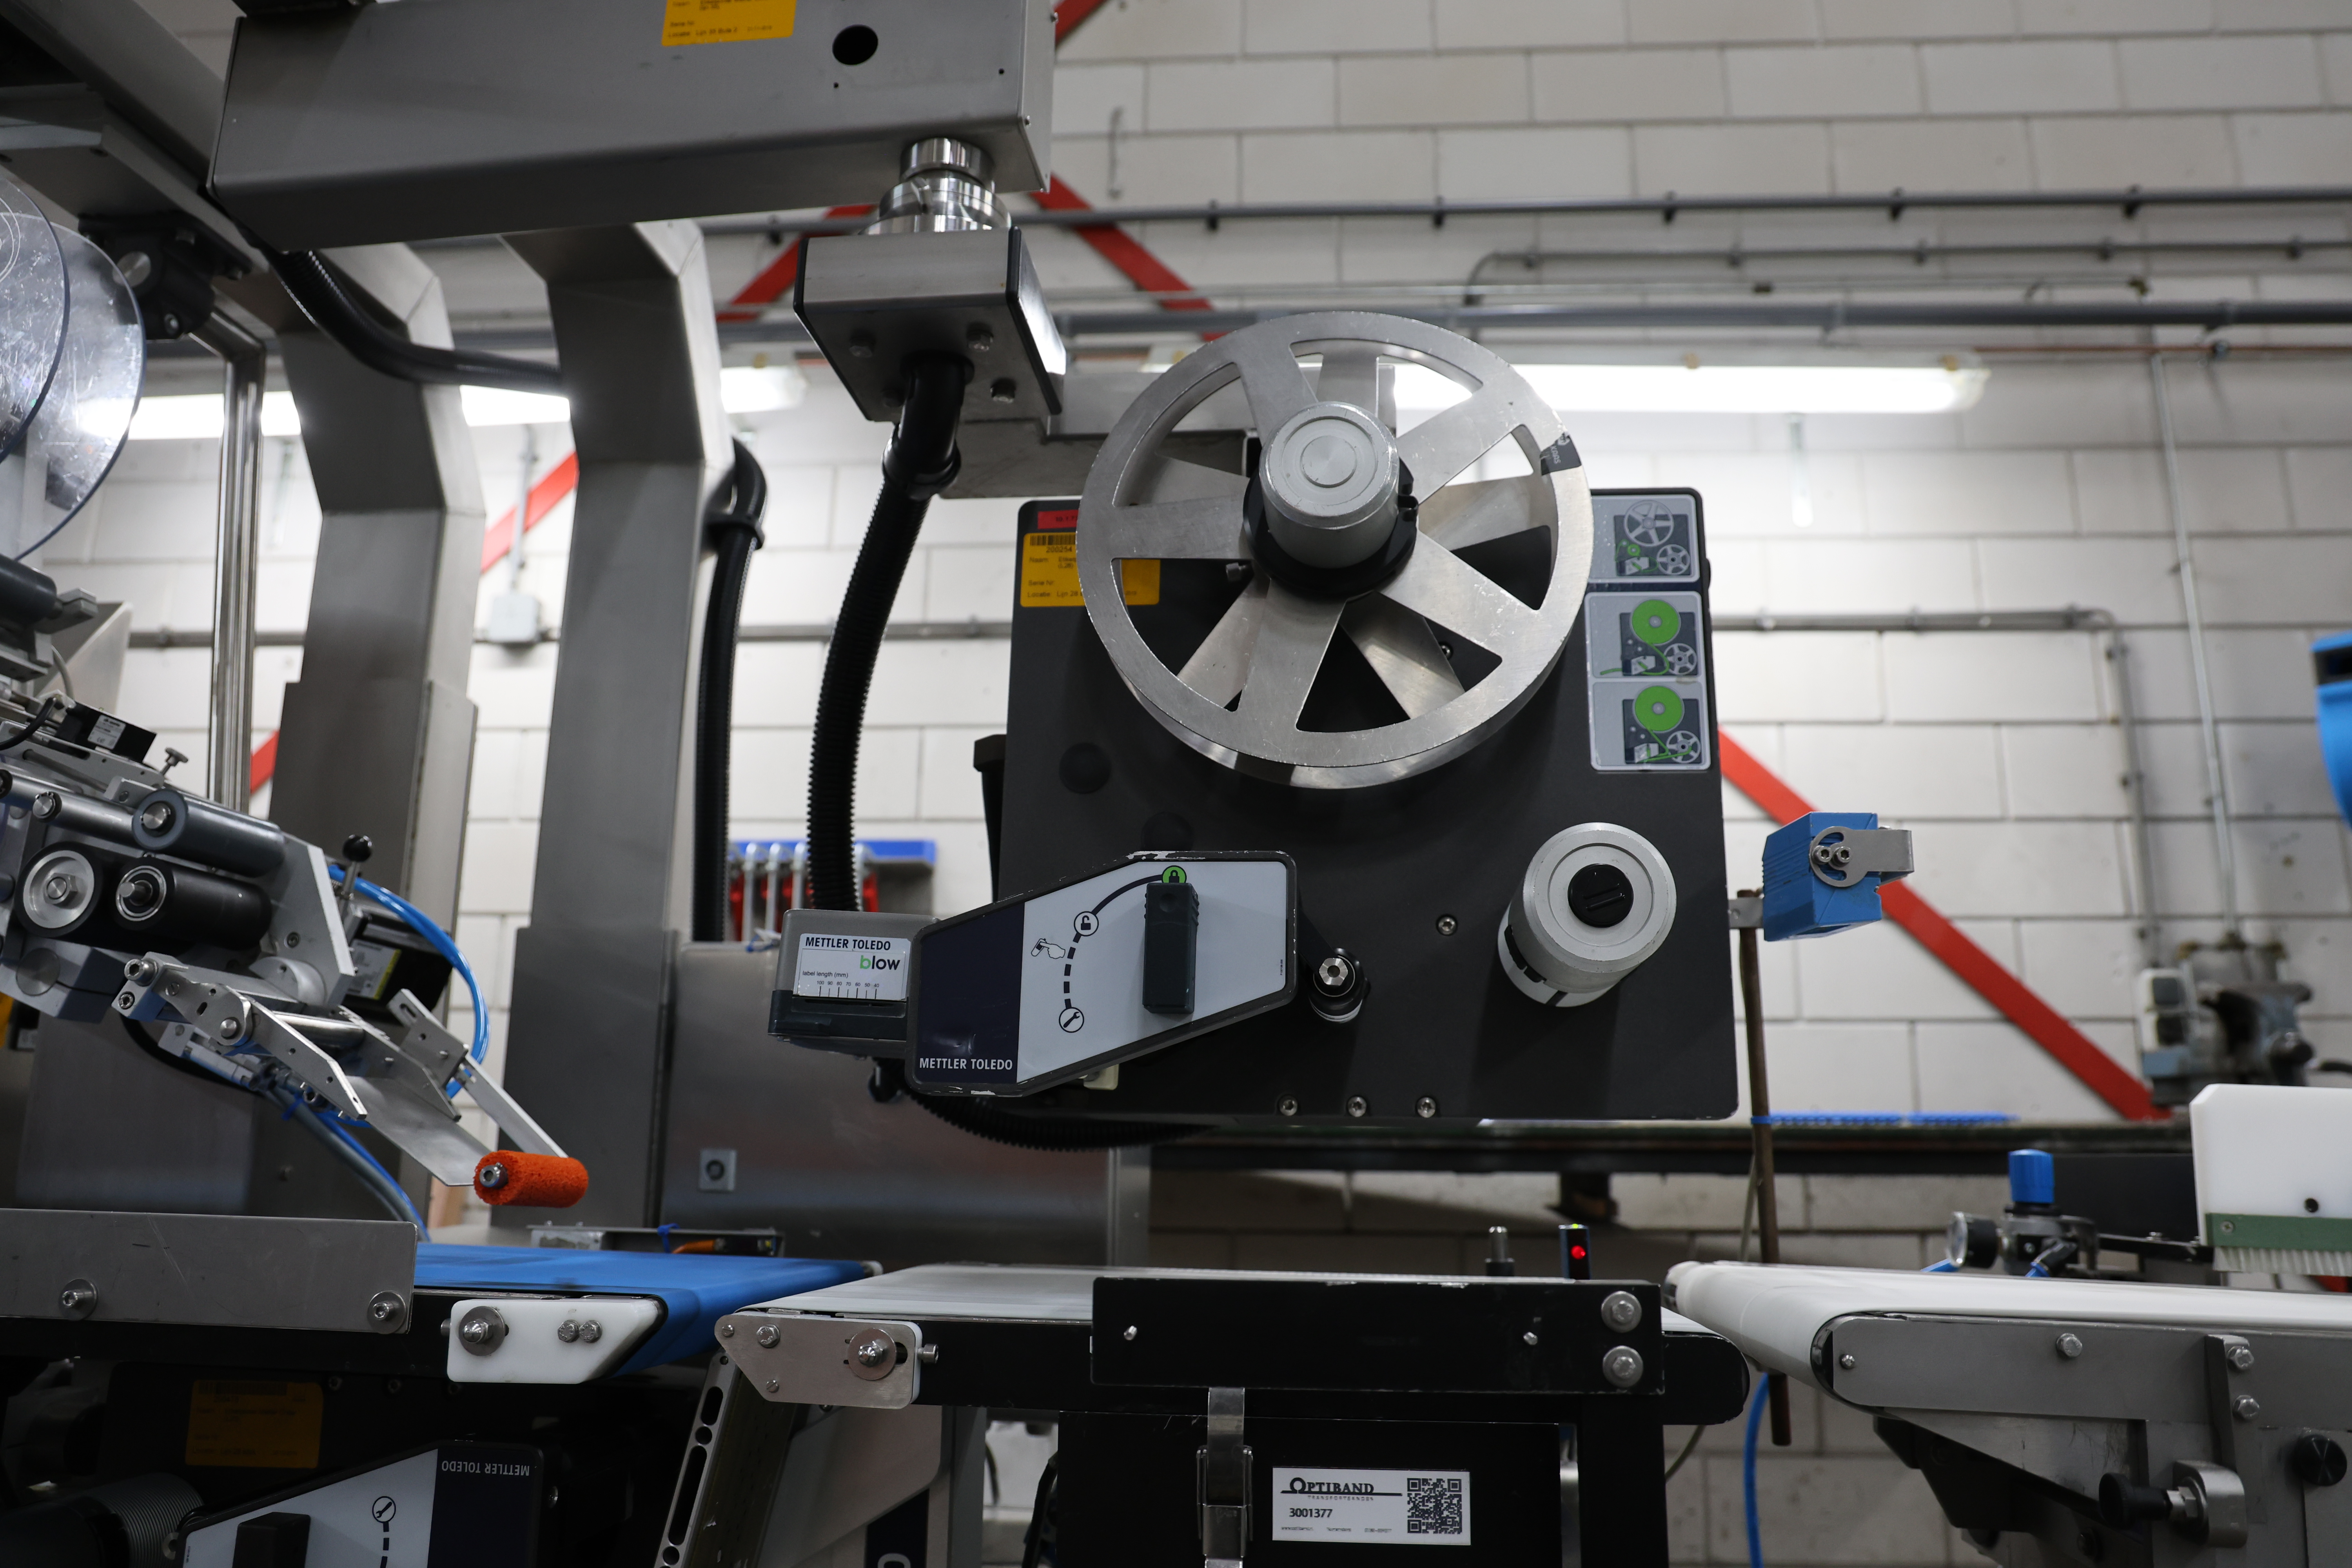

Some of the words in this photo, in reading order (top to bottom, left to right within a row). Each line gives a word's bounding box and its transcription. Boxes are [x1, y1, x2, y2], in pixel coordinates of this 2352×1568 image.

[806, 937, 849, 948] METTLER
[853, 939, 891, 951] TOLEDO
[860, 955, 900, 970] blow
[920, 1058, 967, 1069] METTLER
[971, 1059, 1013, 1070] TOLEDO
[441, 1461, 481, 1473] TOLEDO
[485, 1463, 529, 1476] METTLER
[1289, 1508, 1333, 1517] 3001377
